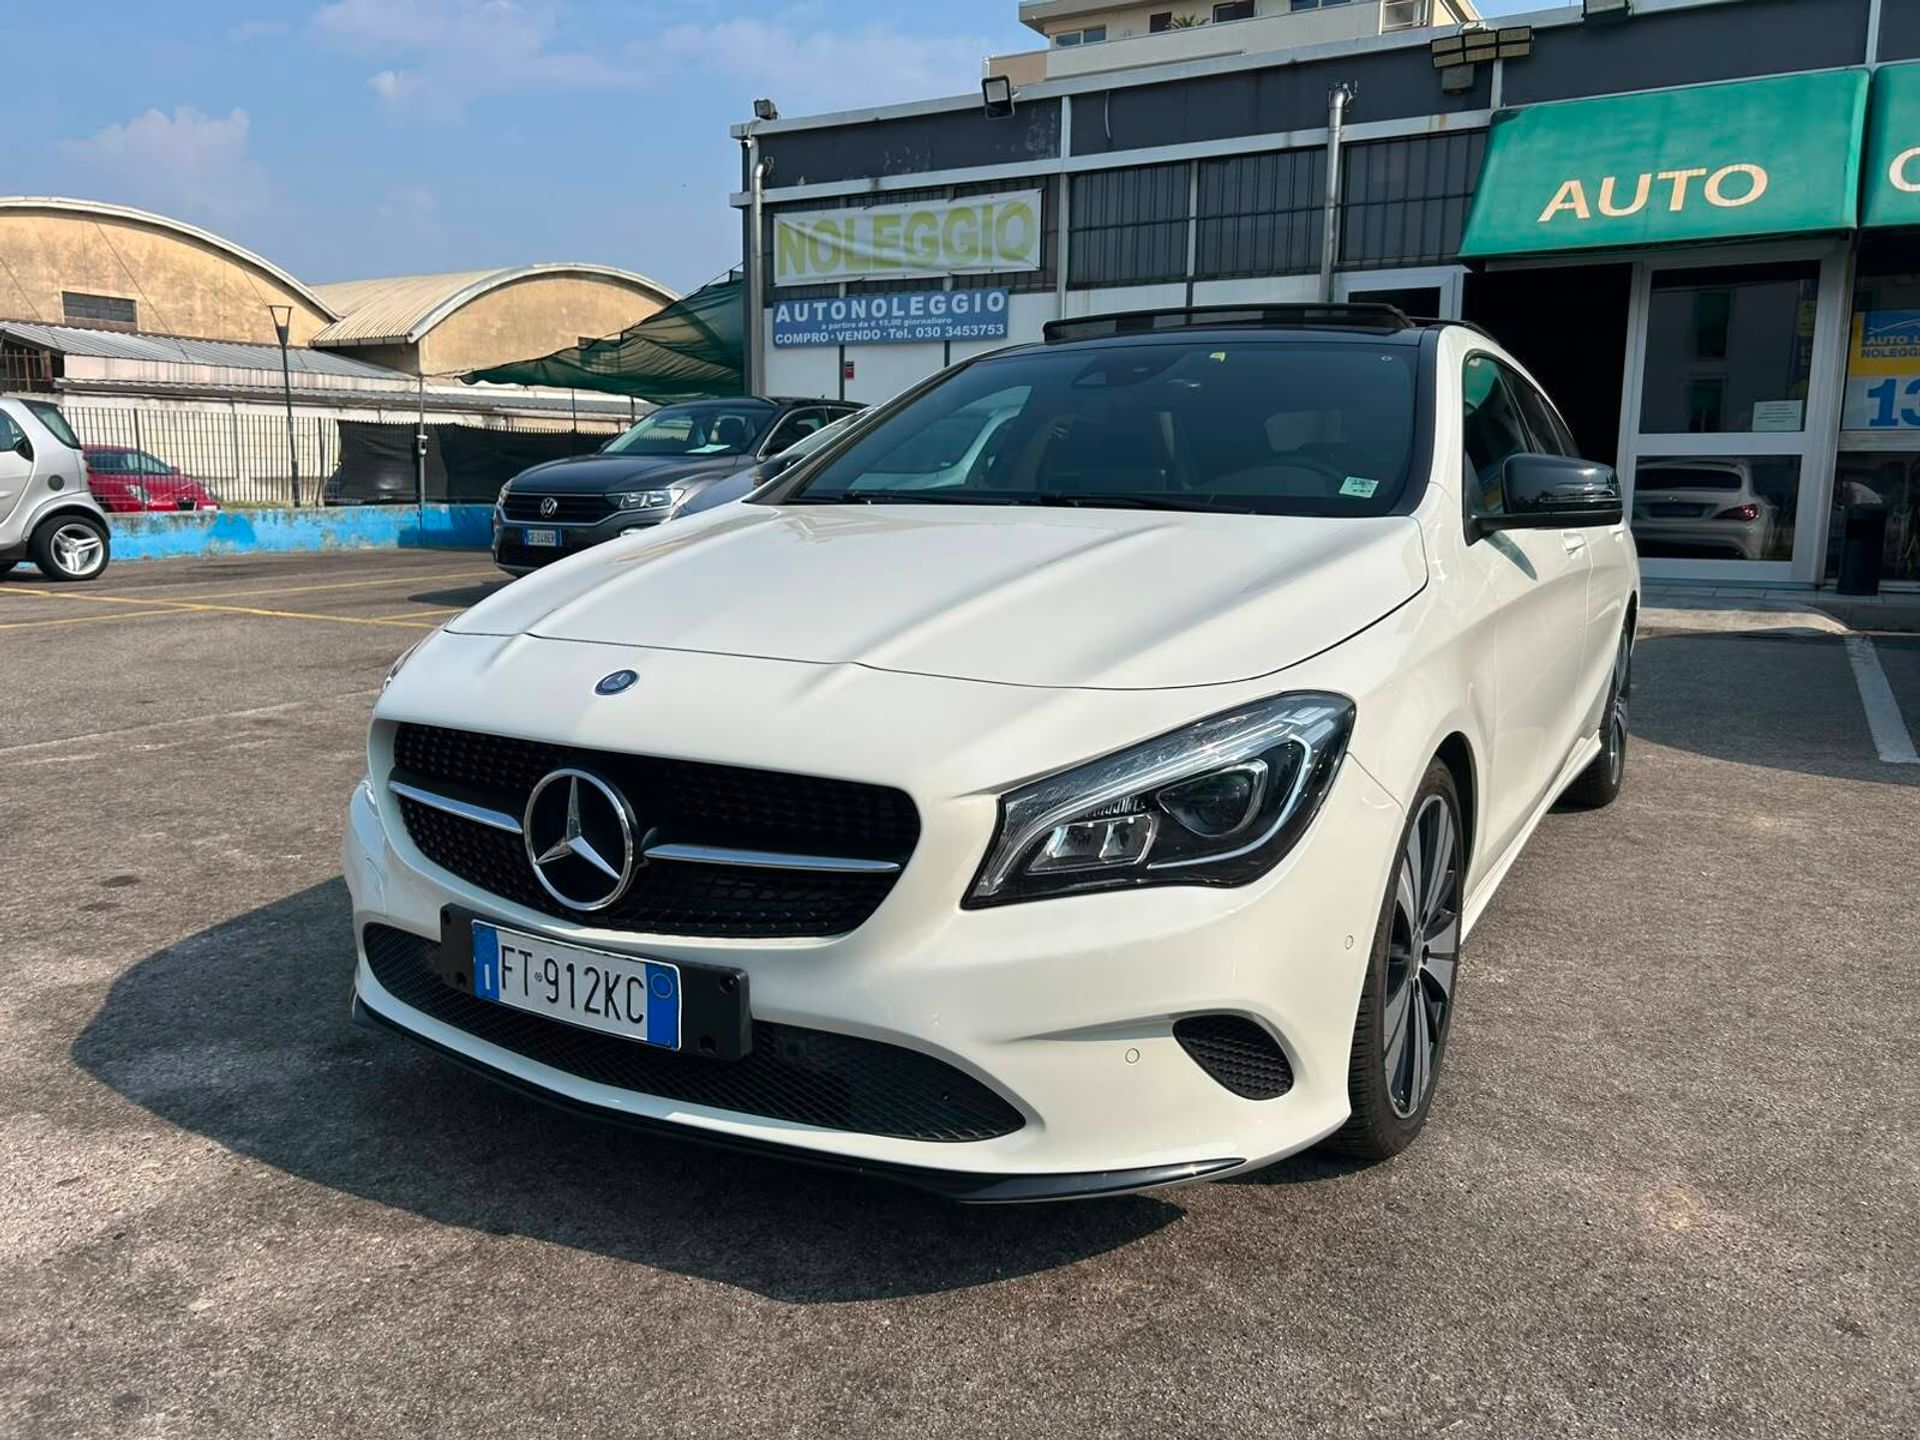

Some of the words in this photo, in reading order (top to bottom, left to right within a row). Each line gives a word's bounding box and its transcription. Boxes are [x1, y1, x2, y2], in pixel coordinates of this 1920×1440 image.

[1537, 163, 1768, 223] AUTO
[778, 201, 1036, 276] NOLEGGIO
[776, 292, 1005, 323] AUTONOLEGGIO
[775, 332, 829, 344] COMPRO
[836, 329, 881, 341] VENDO
[888, 328, 911, 339] Tel.
[916, 326, 940, 338] 030
[945, 324, 1004, 337] 3453753
